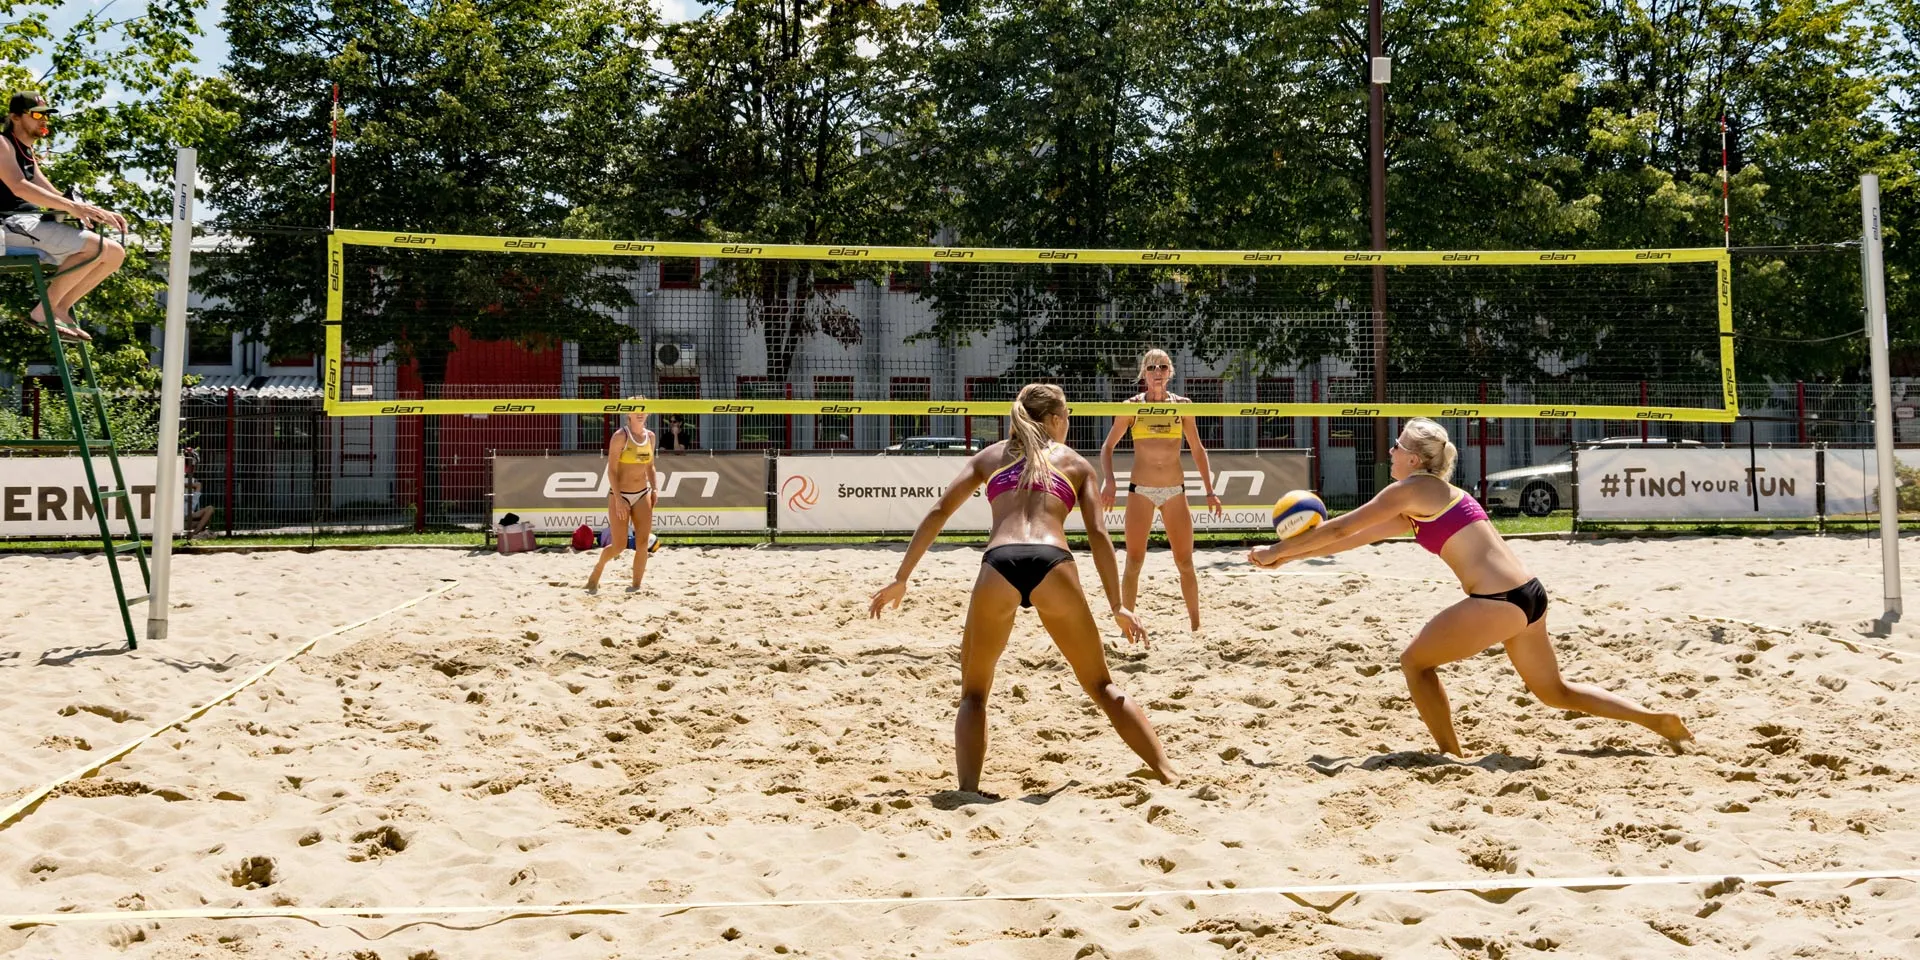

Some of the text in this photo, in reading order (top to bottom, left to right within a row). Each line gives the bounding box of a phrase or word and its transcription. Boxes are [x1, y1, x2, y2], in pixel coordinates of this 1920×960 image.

[179, 183, 187, 220] elan
[394, 234, 436, 245] elan
[504, 239, 546, 248] elan
[614, 243, 654, 251] elan
[722, 245, 762, 254] elan
[828, 248, 868, 256] elan
[934, 249, 974, 257] elan
[1039, 251, 1078, 259] elan
[1142, 252, 1180, 260] elan
[1636, 251, 1672, 259] elan
[1244, 253, 1281, 261] elan
[1344, 253, 1381, 261] elan
[1443, 253, 1479, 261] elan
[1540, 253, 1576, 261] elan
[330, 250, 339, 291] elan
[327, 358, 336, 400] elan
[1725, 367, 1734, 405] elan
[381, 404, 424, 414] elan
[493, 403, 535, 412] elan
[603, 403, 645, 412] elan
[713, 404, 754, 412] elan
[821, 405, 861, 413] elan
[928, 405, 969, 413] elan
[1137, 406, 1177, 415] elan
[1240, 407, 1279, 415] elan
[1341, 408, 1379, 416] elan
[1442, 408, 1479, 416] elan
[1540, 409, 1576, 417] elan
[1636, 411, 1672, 419] elan
[543, 463, 719, 498] eln
[838, 483, 897, 498] ŠPORTNI
[900, 486, 934, 498] PARK
[1691, 480, 1739, 493] YOUR
